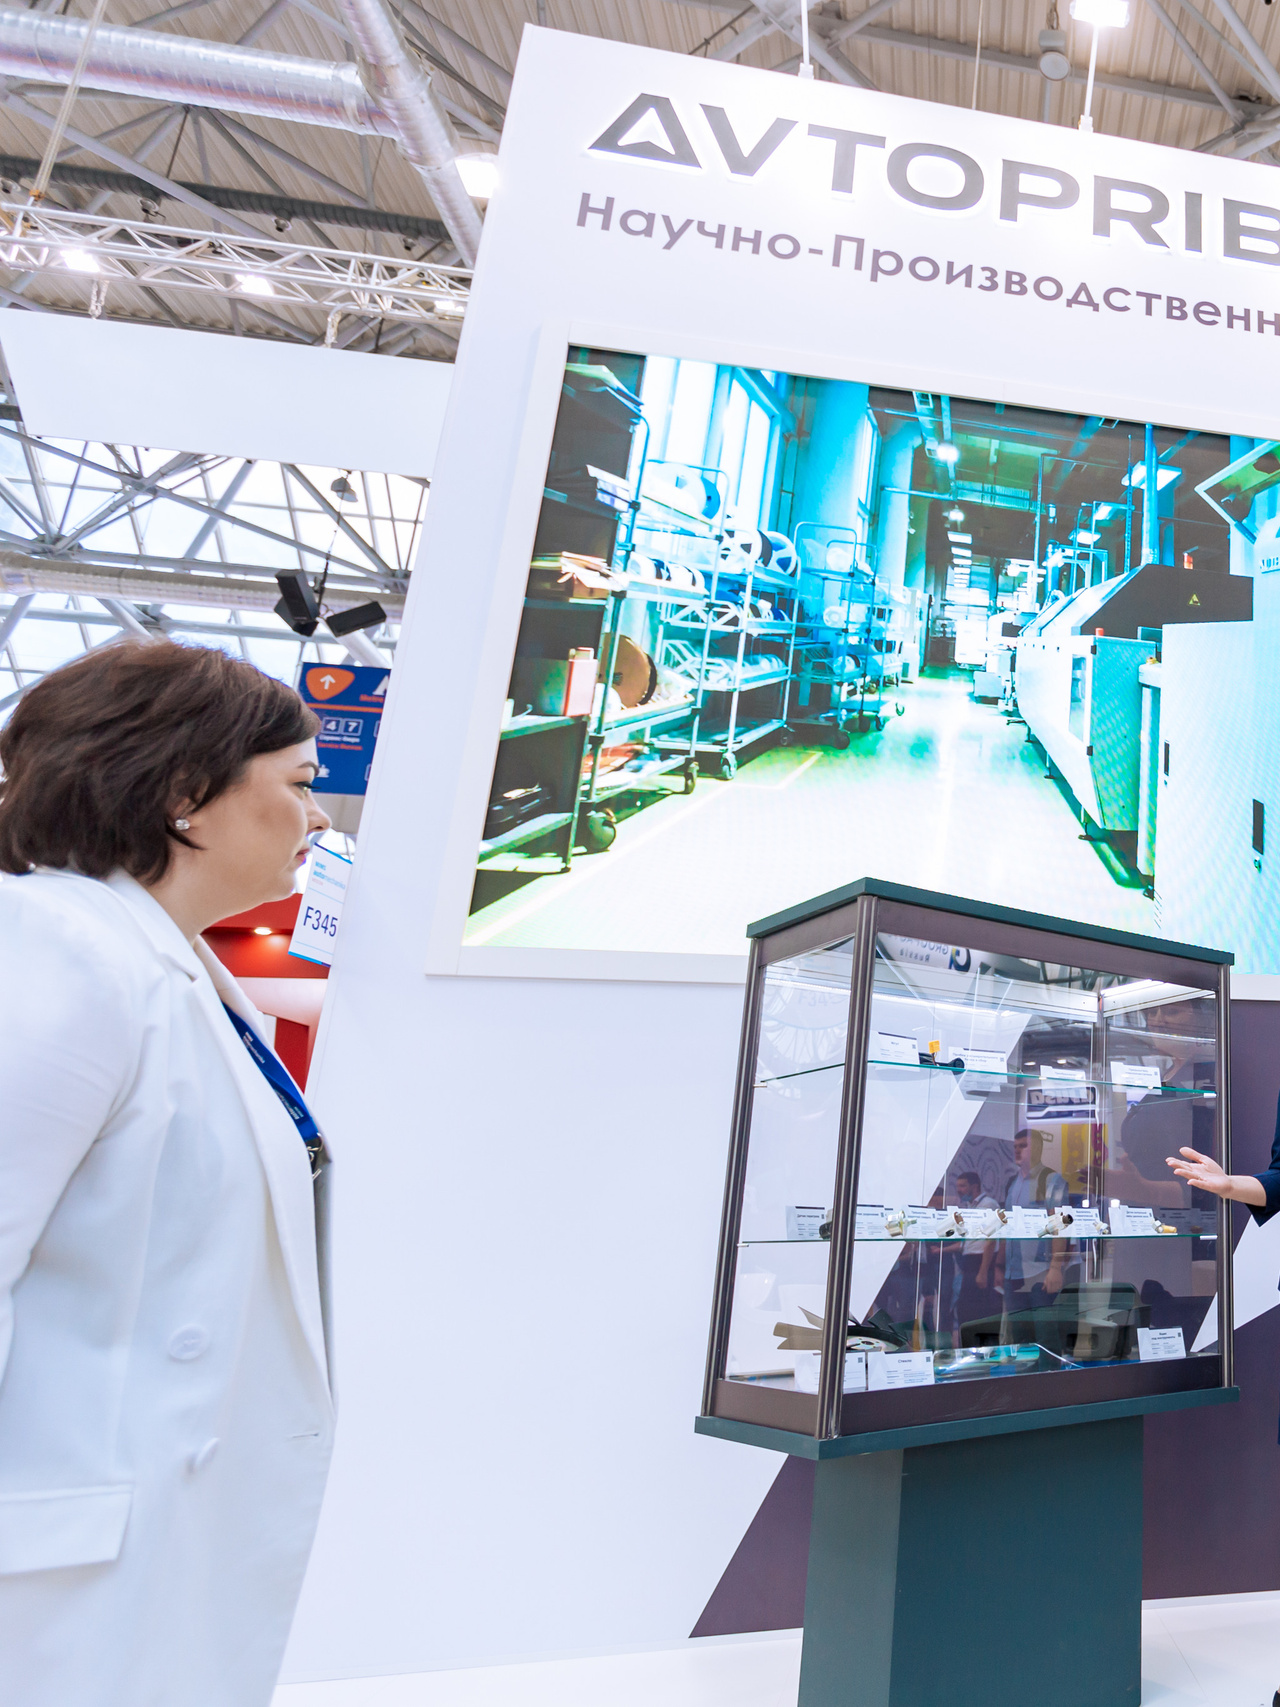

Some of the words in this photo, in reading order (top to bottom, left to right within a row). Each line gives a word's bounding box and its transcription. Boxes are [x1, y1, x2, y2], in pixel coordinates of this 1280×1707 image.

[325, 720, 338, 731] 4
[347, 721, 359, 732] 7
[303, 905, 338, 938] F345
